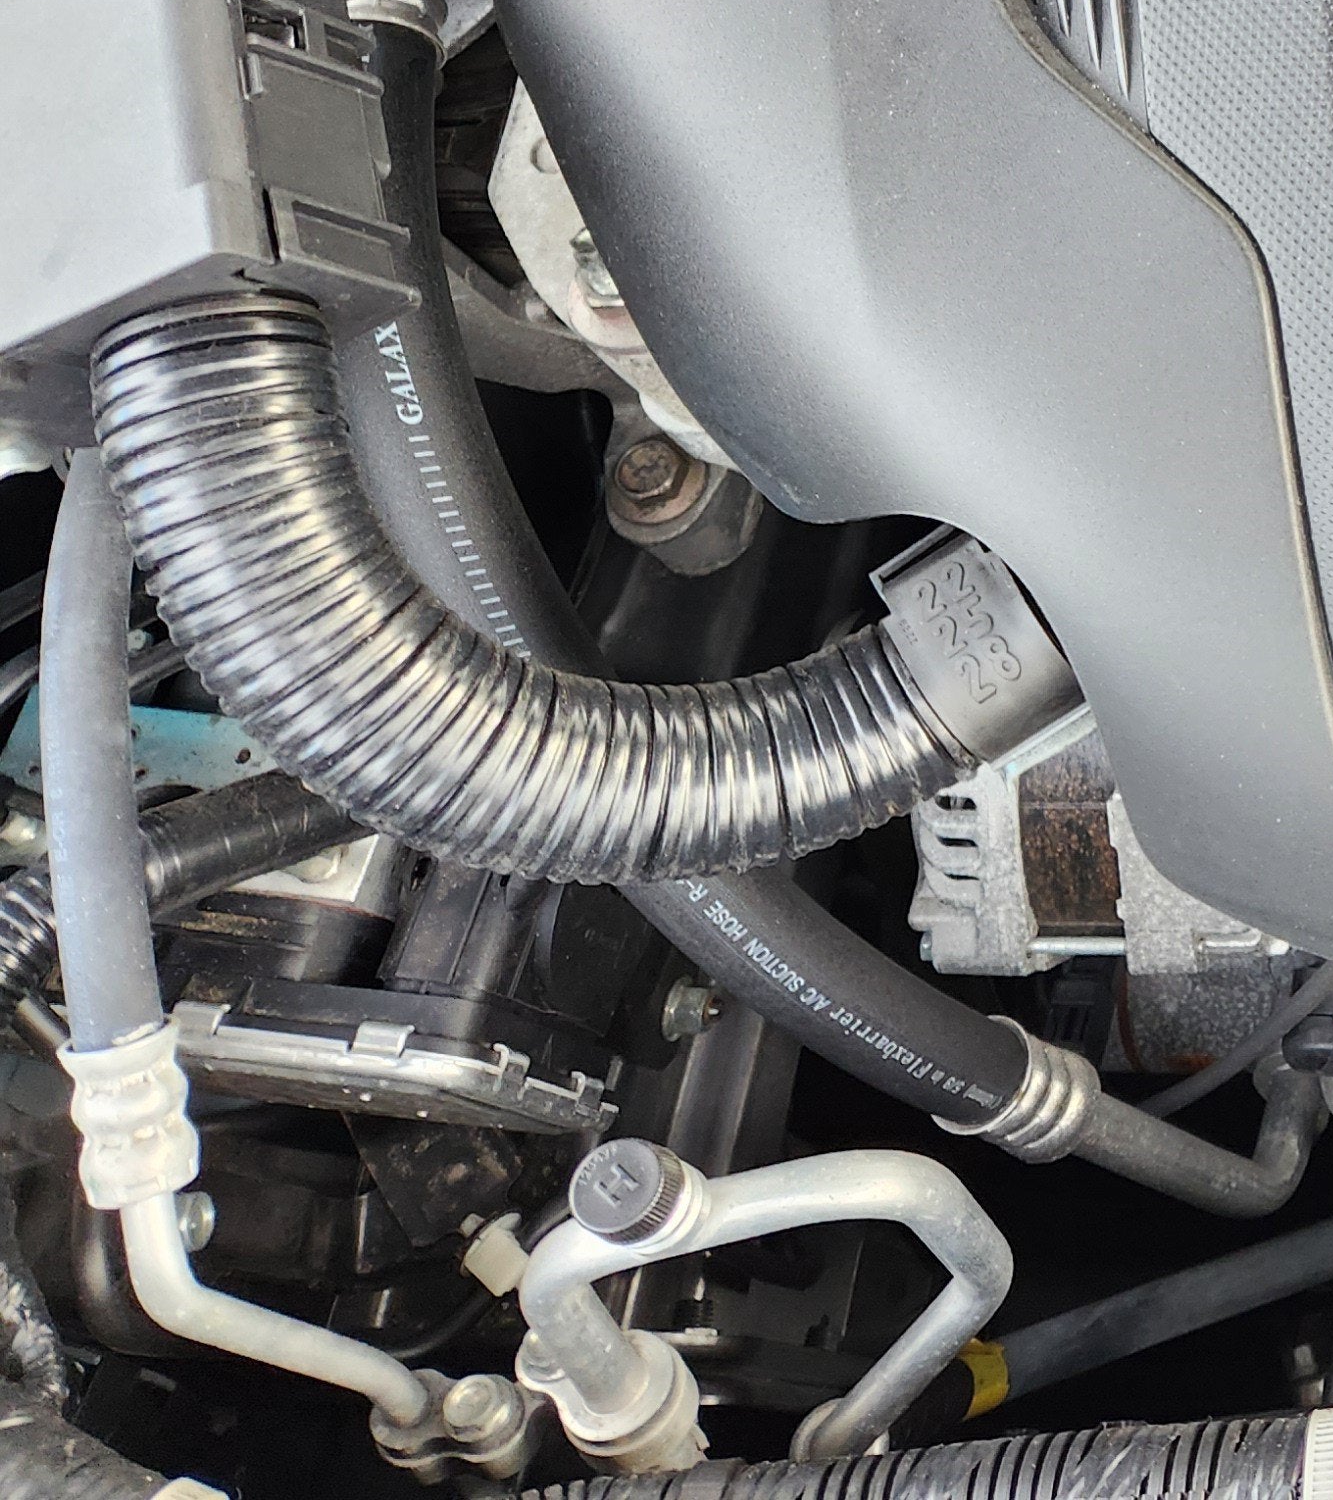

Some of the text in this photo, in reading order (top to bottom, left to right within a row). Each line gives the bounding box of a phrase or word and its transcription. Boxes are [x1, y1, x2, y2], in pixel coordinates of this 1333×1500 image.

[703, 899, 747, 942] HOSE
[743, 935, 805, 993] SUCTION
[800, 985, 832, 1014] A/C
[830, 1005, 936, 1082] Flexbarrier
[593, 1163, 640, 1208] H
